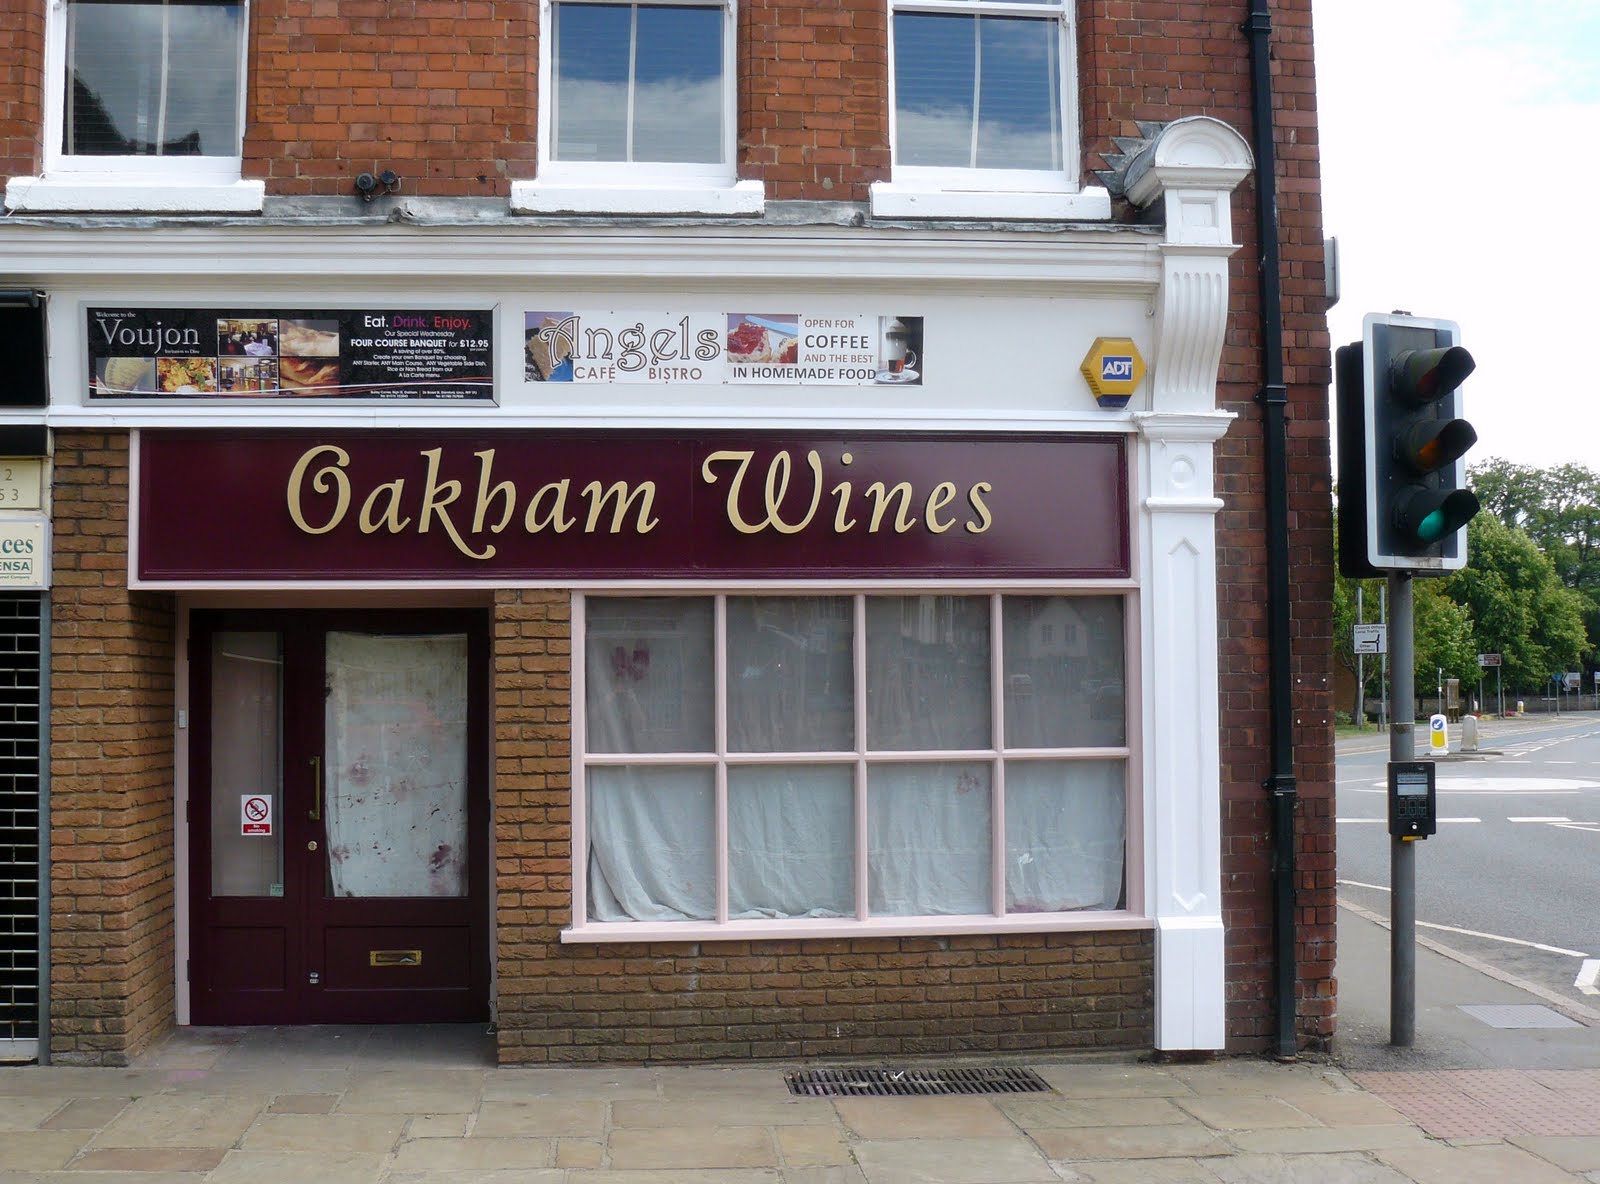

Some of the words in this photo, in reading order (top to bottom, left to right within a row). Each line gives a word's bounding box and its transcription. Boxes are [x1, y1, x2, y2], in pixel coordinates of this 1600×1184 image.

[364, 316, 389, 328] Eat.
[393, 316, 429, 328] Drink.
[434, 316, 471, 330] Enjoy.
[805, 319, 832, 328] OPEN
[835, 320, 854, 328] FOR
[96, 318, 200, 354] Voujon
[420, 330, 455, 338] Wednesday
[351, 339, 373, 347] FOUR
[375, 339, 408, 347] COURSE
[410, 339, 446, 347] BANQUET
[539, 316, 720, 372] Angels
[805, 335, 869, 349] COFFEE
[804, 354, 827, 363] AND
[829, 354, 849, 363] THE
[851, 355, 874, 363] BEST
[574, 363, 616, 379] CAFÉ
[649, 368, 702, 380] BISTRO
[733, 367, 747, 378] IN
[752, 367, 834, 379] HOMEMADE
[839, 369, 876, 380] FOOD
[1102, 361, 1132, 375] ADT
[286, 445, 660, 559] Oakham
[701, 450, 994, 535] Wines
[0, 539, 33, 553] ces
